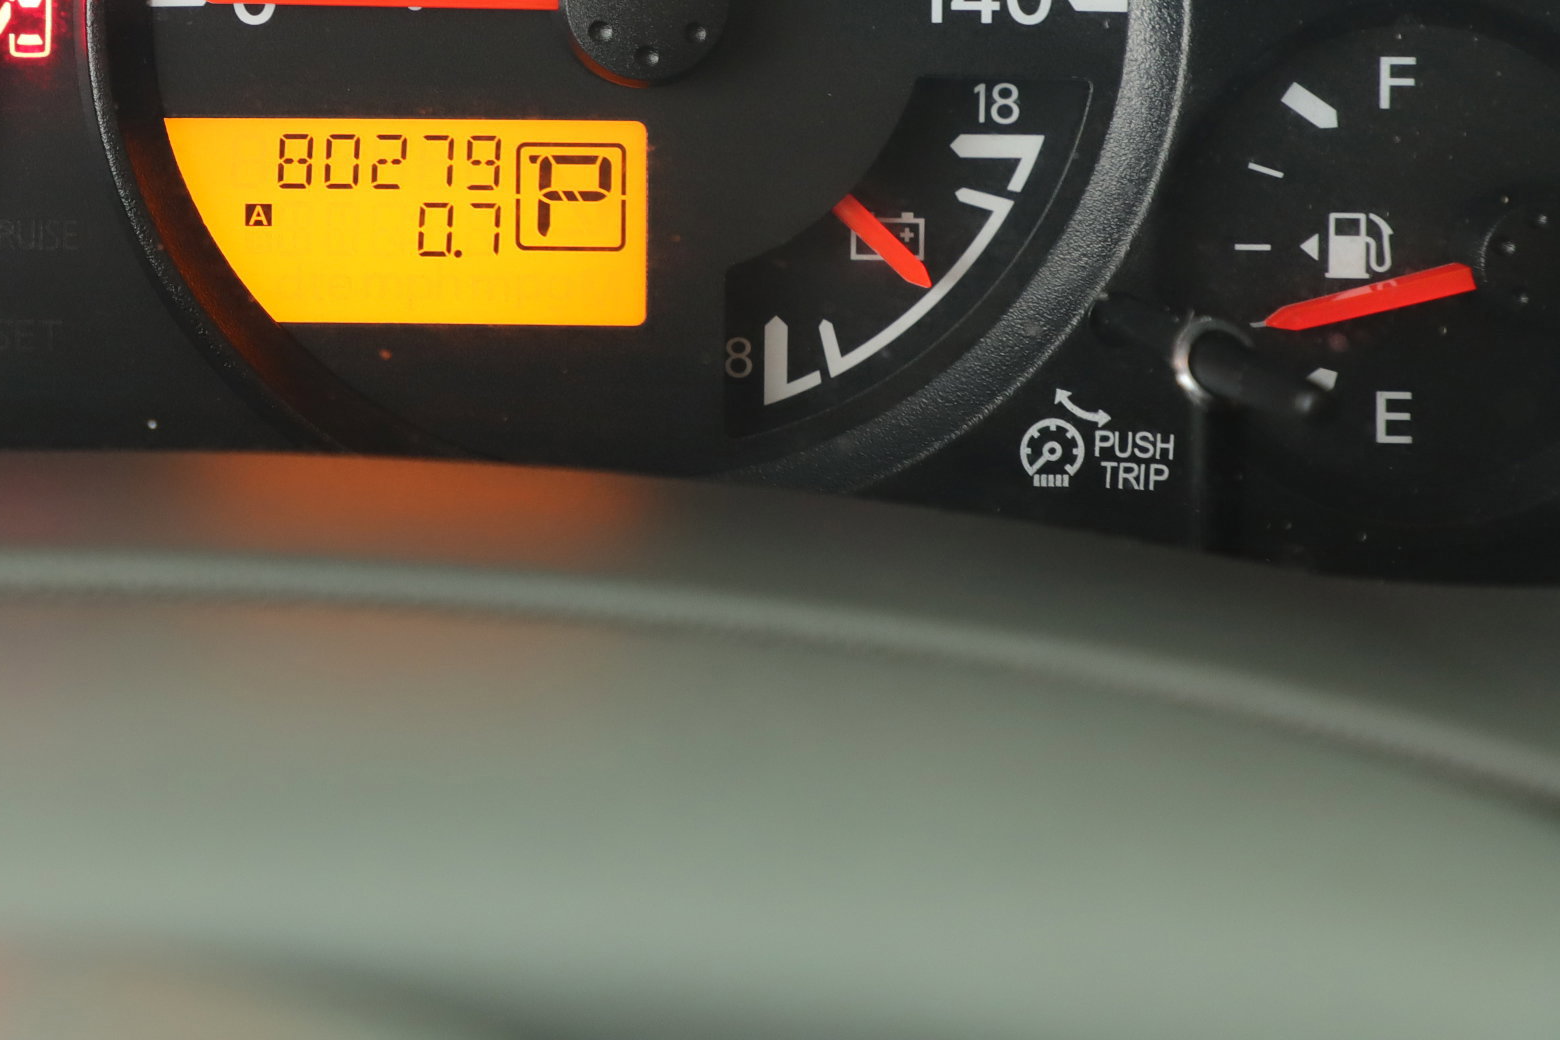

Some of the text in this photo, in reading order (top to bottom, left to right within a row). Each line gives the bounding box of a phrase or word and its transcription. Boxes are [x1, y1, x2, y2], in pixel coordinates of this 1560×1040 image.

[973, 82, 1020, 125] 18
[1379, 56, 1417, 110] F
[277, 133, 502, 191] 80279
[528, 154, 613, 238] P
[417, 202, 501, 258] 0.7
[725, 337, 753, 378] 8
[1375, 391, 1413, 444] E
[1094, 430, 1175, 460] PUSH
[1100, 461, 1170, 491] TRIP
